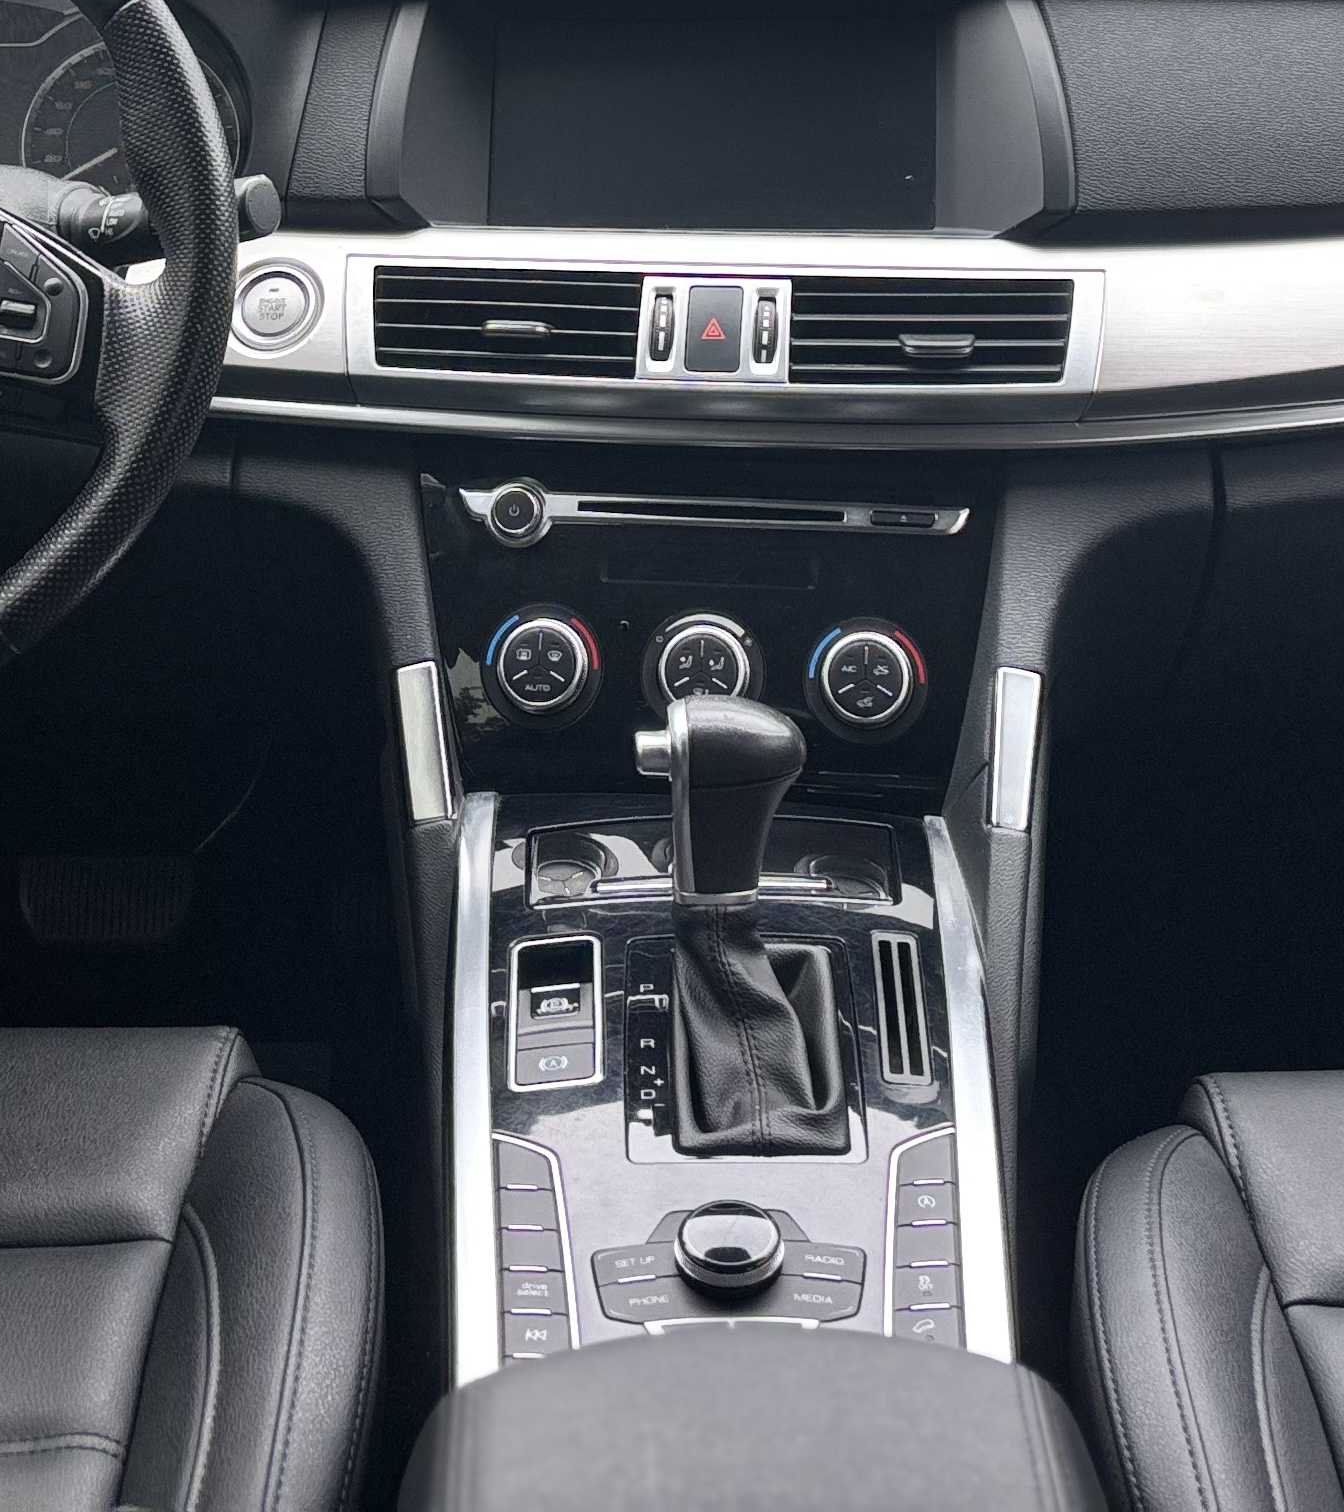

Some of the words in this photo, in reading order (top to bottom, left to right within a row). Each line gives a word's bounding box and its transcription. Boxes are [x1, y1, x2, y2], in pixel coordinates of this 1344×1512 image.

[257, 304, 287, 313] START
[258, 312, 285, 321] STOP
[524, 683, 551, 693] AUTO
[639, 983, 654, 993] P
[640, 1038, 656, 1049] R
[640, 1065, 656, 1075] N
[640, 1089, 656, 1100] D
[614, 1257, 635, 1268] SET
[639, 1255, 656, 1266] UP
[804, 1253, 845, 1266] RADIO
[521, 1281, 549, 1290] drive
[628, 1294, 670, 1307] PHONE
[793, 1292, 833, 1305] MEDIA
